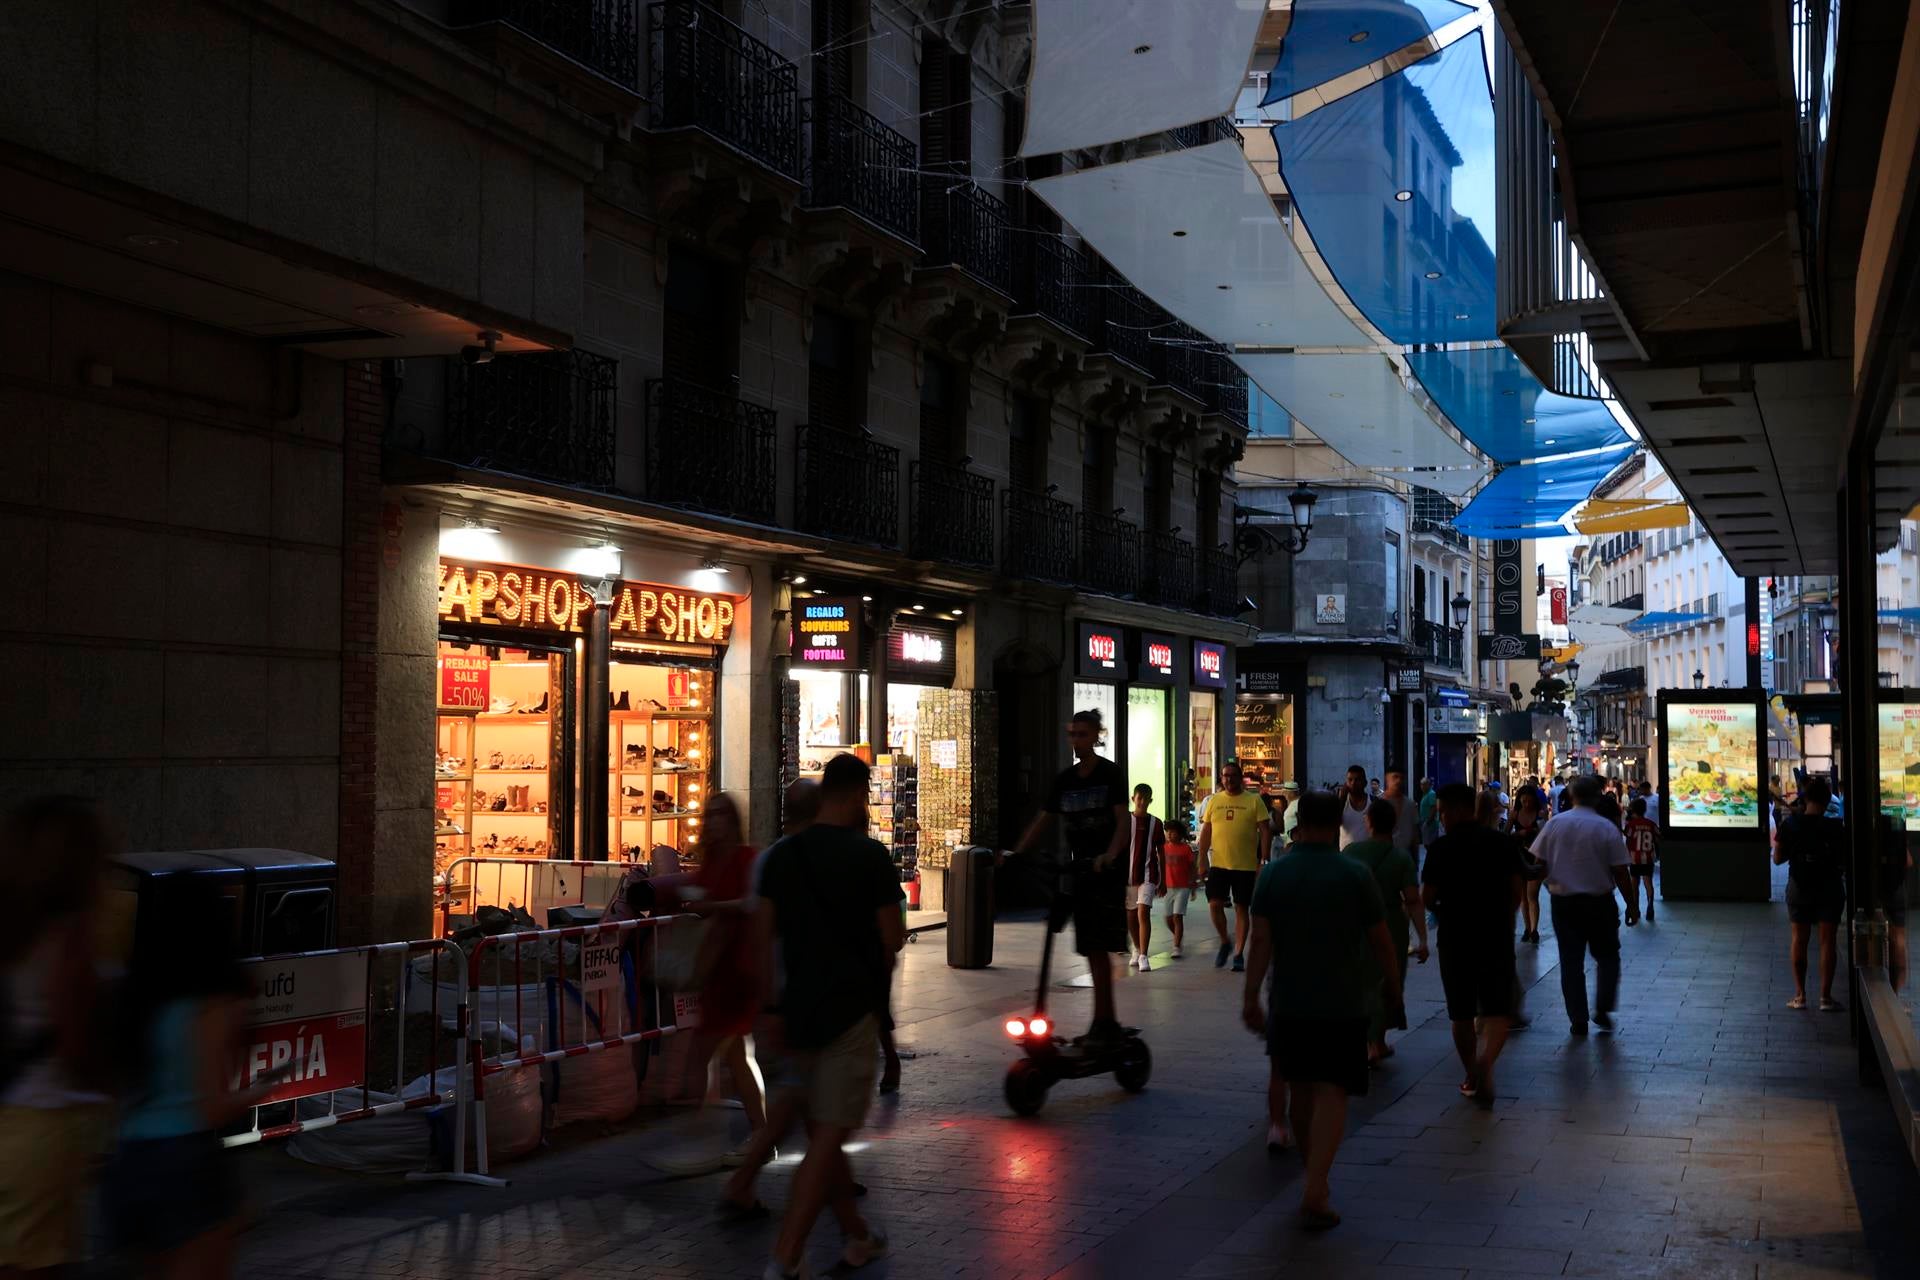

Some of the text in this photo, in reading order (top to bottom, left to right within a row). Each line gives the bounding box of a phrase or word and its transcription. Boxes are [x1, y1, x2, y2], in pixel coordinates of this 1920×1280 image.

[610, 588, 734, 641] APSHOP
[806, 606, 844, 618] REGALOS
[800, 620, 849, 632] SOUVENIRS
[812, 634, 837, 646] GIFTS
[804, 649, 845, 660] FOOTBALL
[445, 658, 488, 670] REBAJAS
[454, 671, 478, 682] SALE
[1250, 672, 1279, 680] FRESH
[1400, 669, 1419, 677] LUSH
[1633, 830, 1653, 852] 18
[265, 972, 295, 997] ufd
